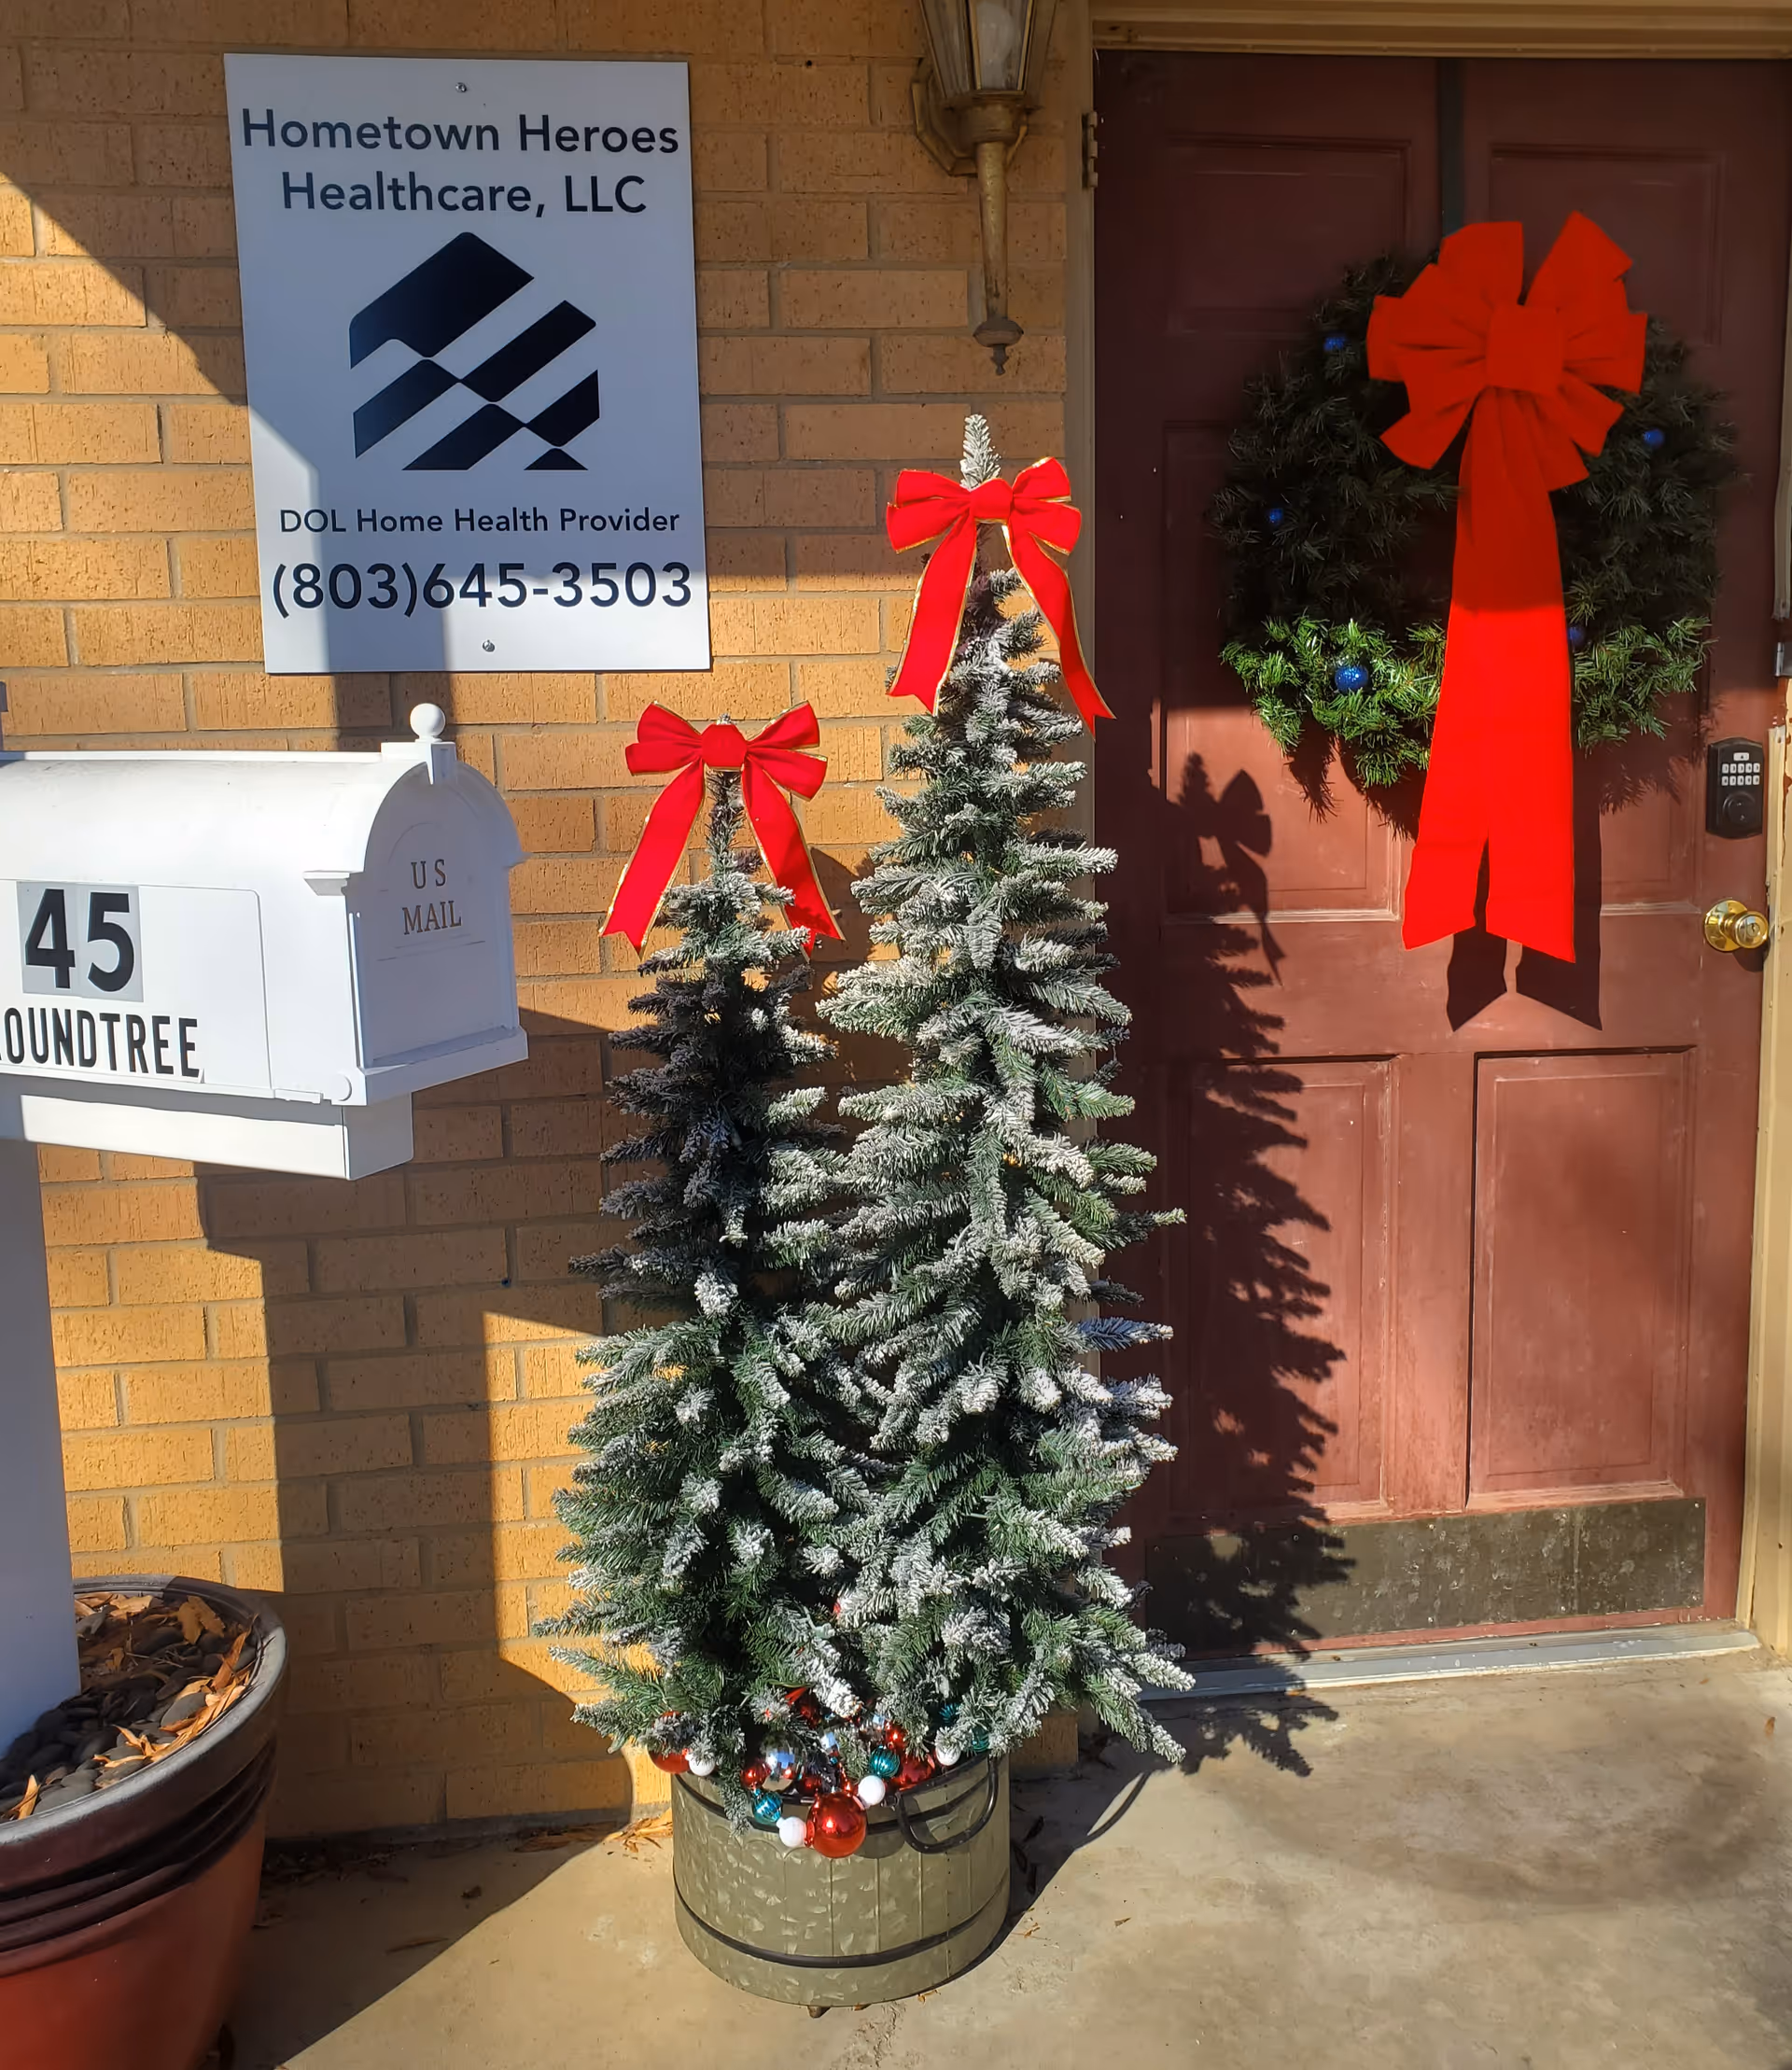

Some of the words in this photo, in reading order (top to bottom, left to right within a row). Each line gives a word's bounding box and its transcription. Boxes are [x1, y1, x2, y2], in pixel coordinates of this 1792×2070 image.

[243, 108, 499, 151] Hometown
[519, 114, 679, 154] Heroes
[282, 170, 545, 218] Healthcare,
[565, 175, 647, 214] LLC
[280, 509, 346, 533] DOL
[357, 509, 443, 533] Home
[454, 506, 549, 532] Health
[559, 506, 680, 532] Provider
[273, 561, 692, 620] (803)645-3503
[24, 888, 135, 993] 45
[401, 900, 462, 936] MAIL
[0, 1007, 200, 1078] OUNDTREE
